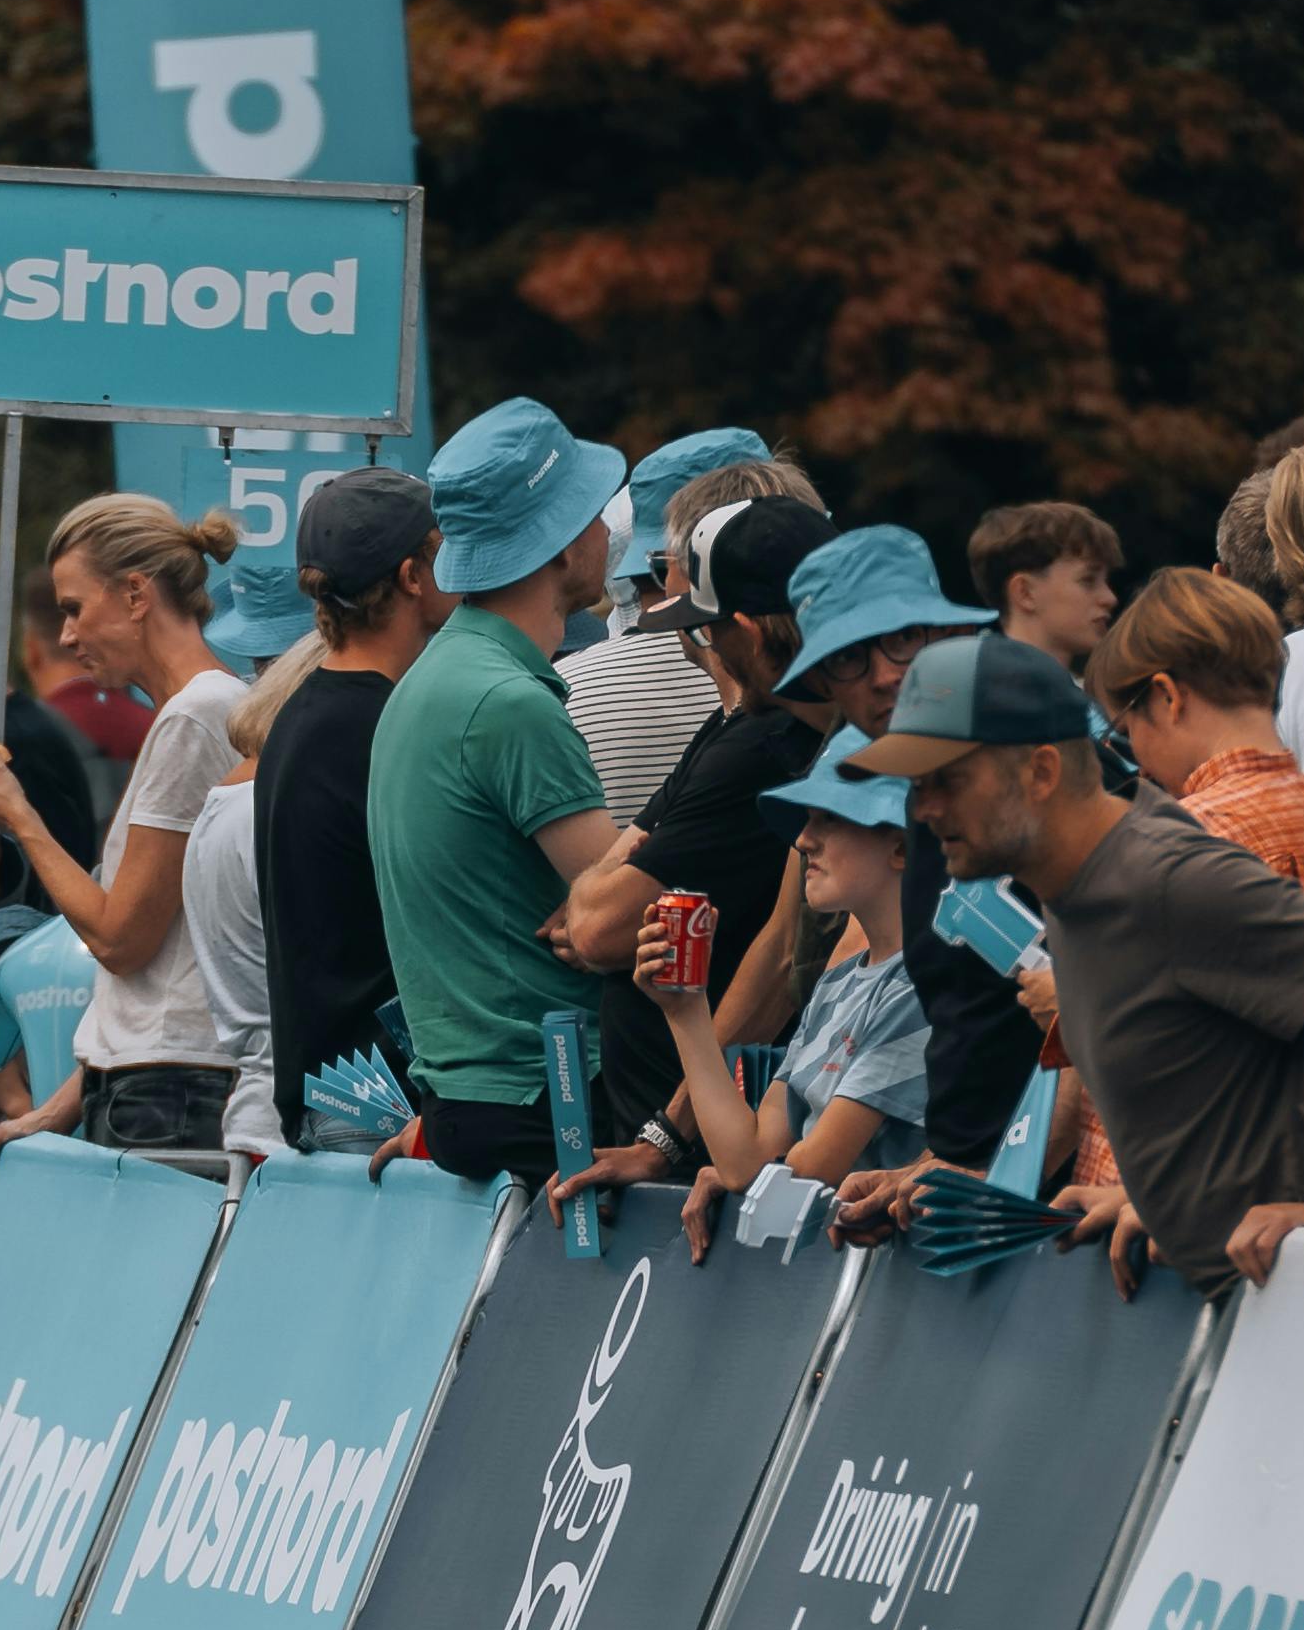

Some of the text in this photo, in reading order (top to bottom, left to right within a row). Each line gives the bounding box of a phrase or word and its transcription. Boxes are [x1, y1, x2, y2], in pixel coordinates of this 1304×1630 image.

[311, 1088, 361, 1117] postnord
[553, 1034, 574, 1103] postnord
[111, 1399, 412, 1616] postnord
[799, 1455, 979, 1623] Driving in
